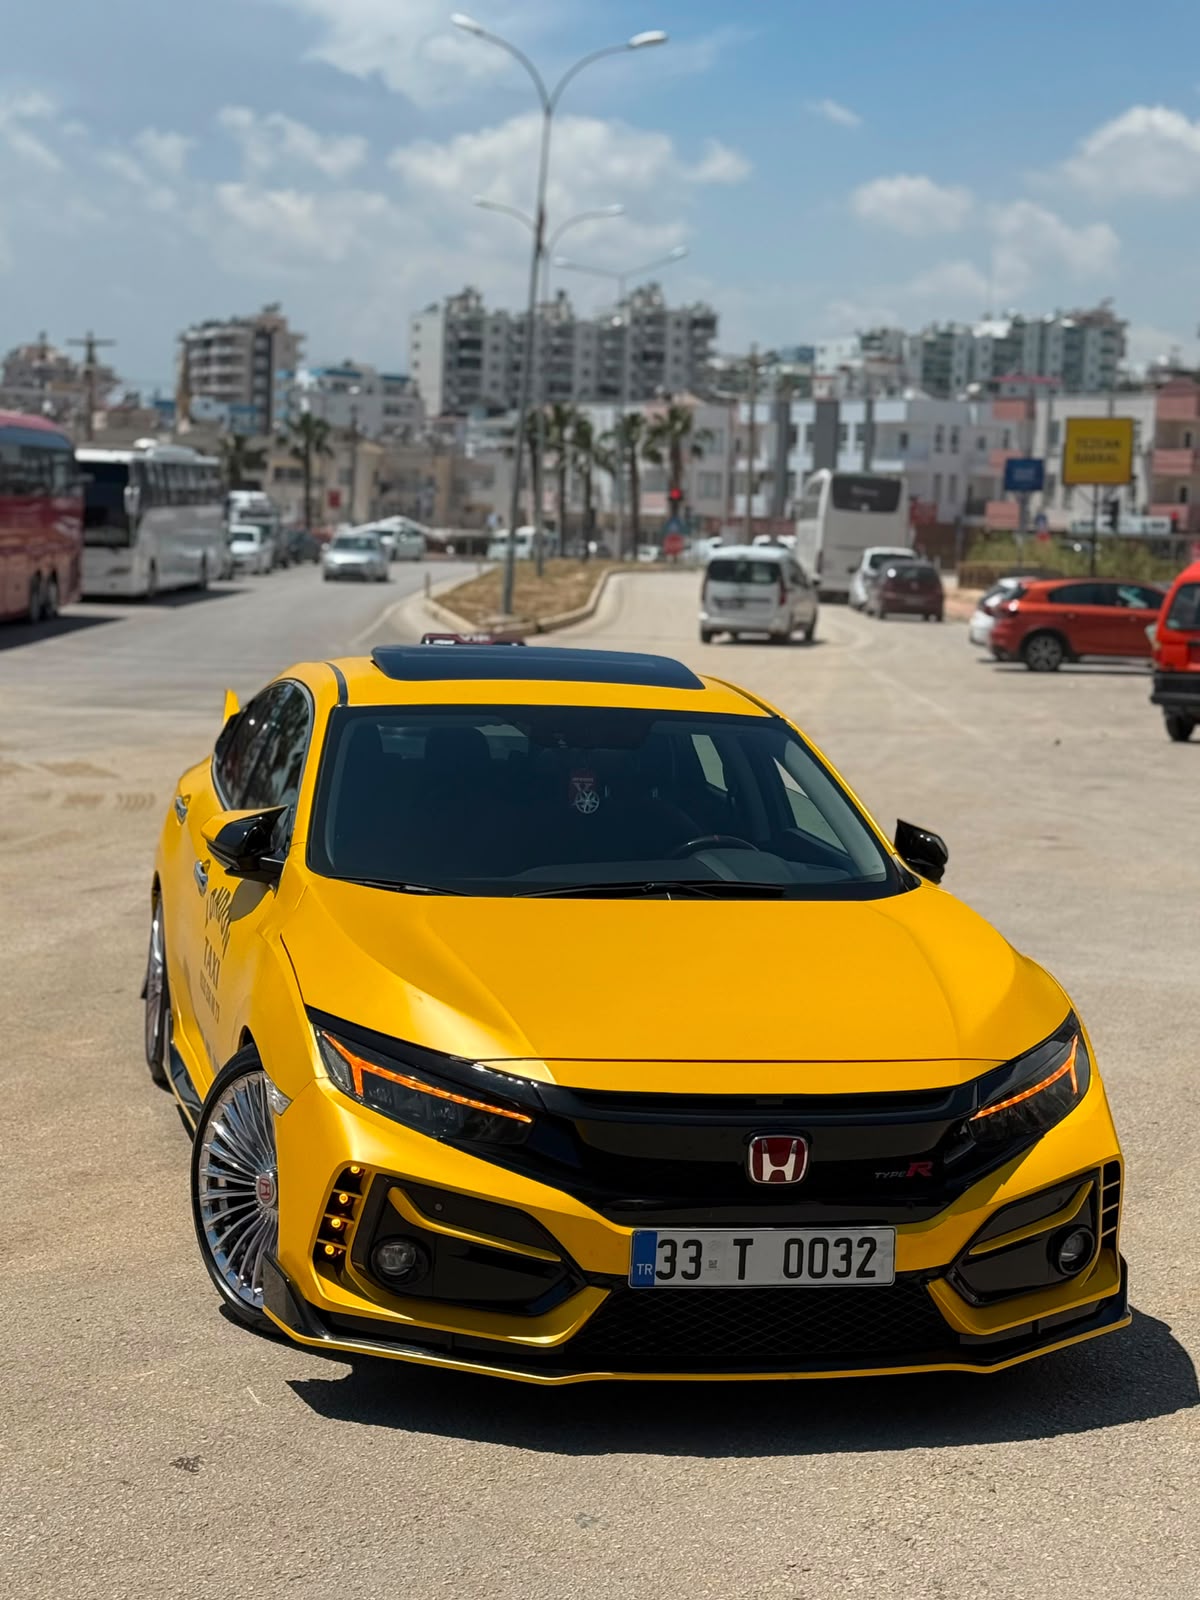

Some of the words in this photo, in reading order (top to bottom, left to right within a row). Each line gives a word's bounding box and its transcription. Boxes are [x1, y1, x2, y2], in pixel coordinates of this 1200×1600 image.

[204, 935, 221, 990] TAXI
[905, 1161, 934, 1177] R
[636, 1263, 653, 1276] TR
[655, 1238, 703, 1281] 33
[732, 1238, 754, 1281] T
[782, 1236, 878, 1279] 0032
